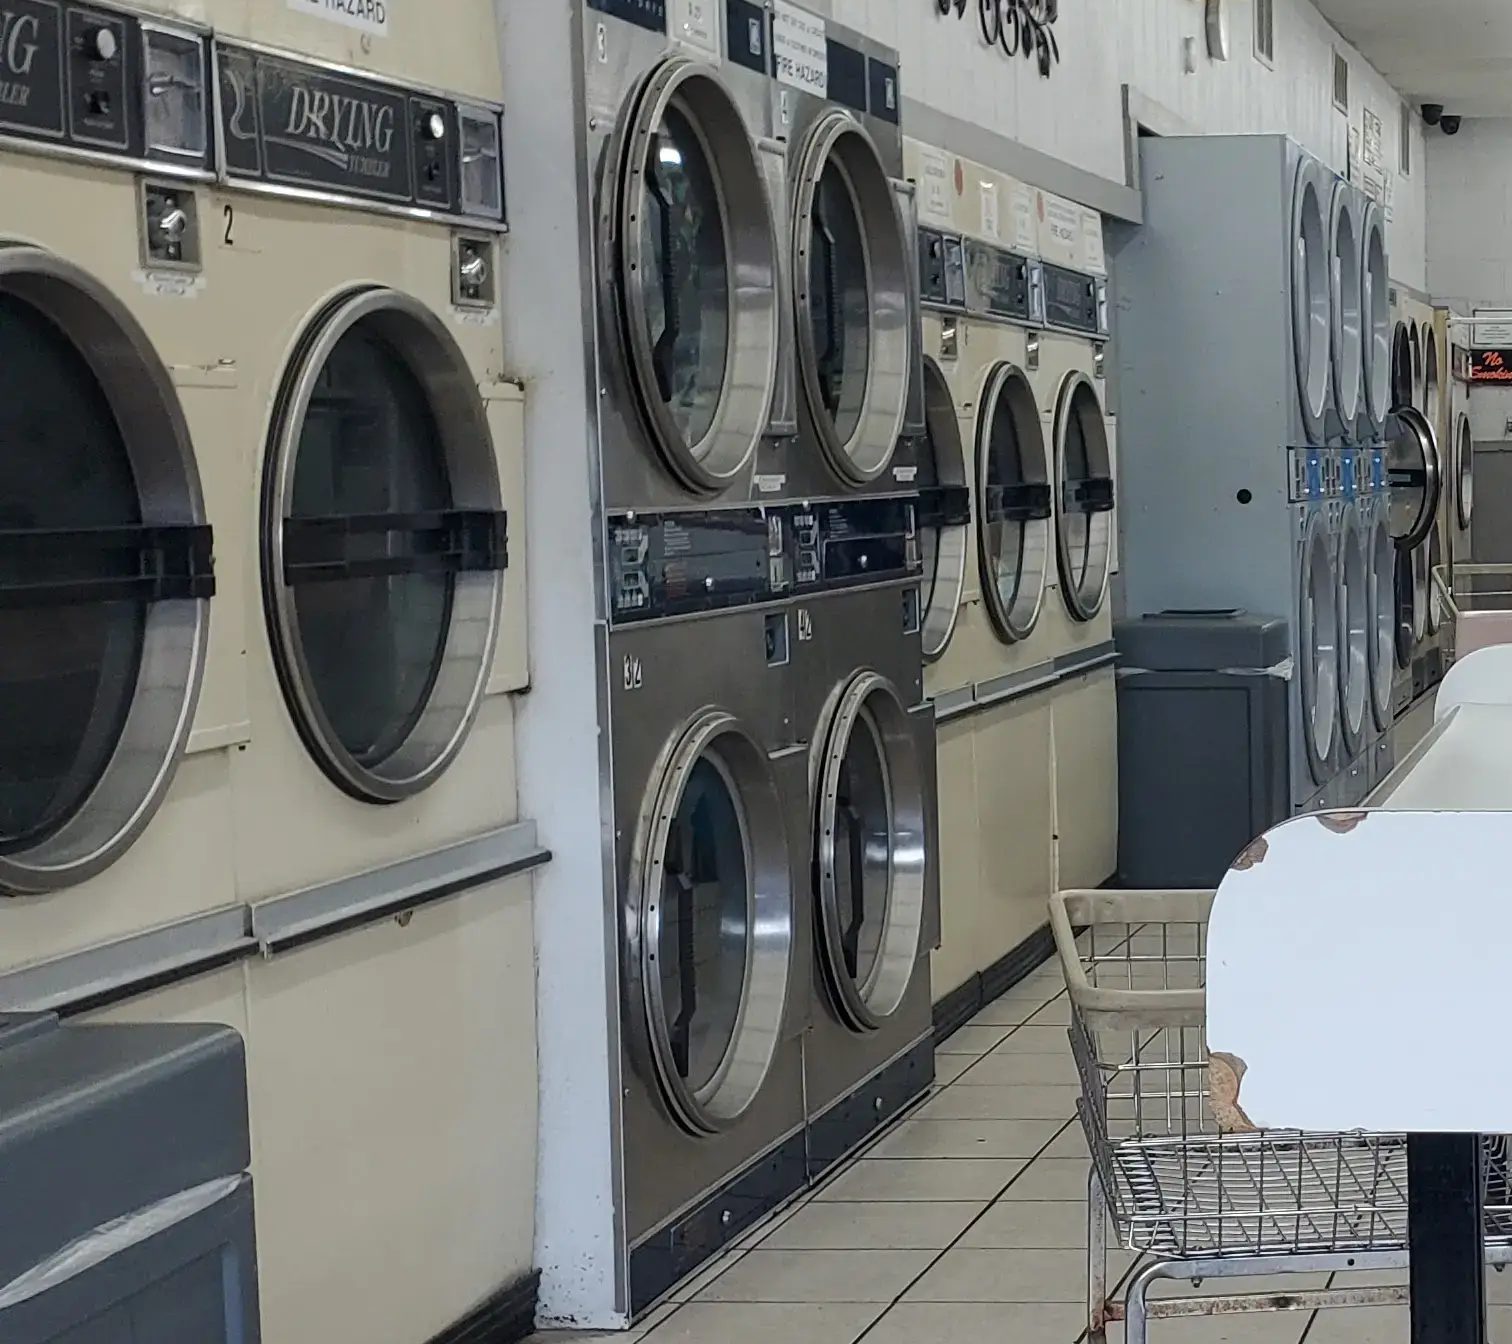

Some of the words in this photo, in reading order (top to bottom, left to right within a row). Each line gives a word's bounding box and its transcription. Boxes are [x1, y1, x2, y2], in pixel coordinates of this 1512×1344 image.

[795, 62, 825, 90] HAZARD
[285, 85, 396, 154] DRYING
[224, 204, 234, 245] 2
[1482, 351, 1504, 367] No
